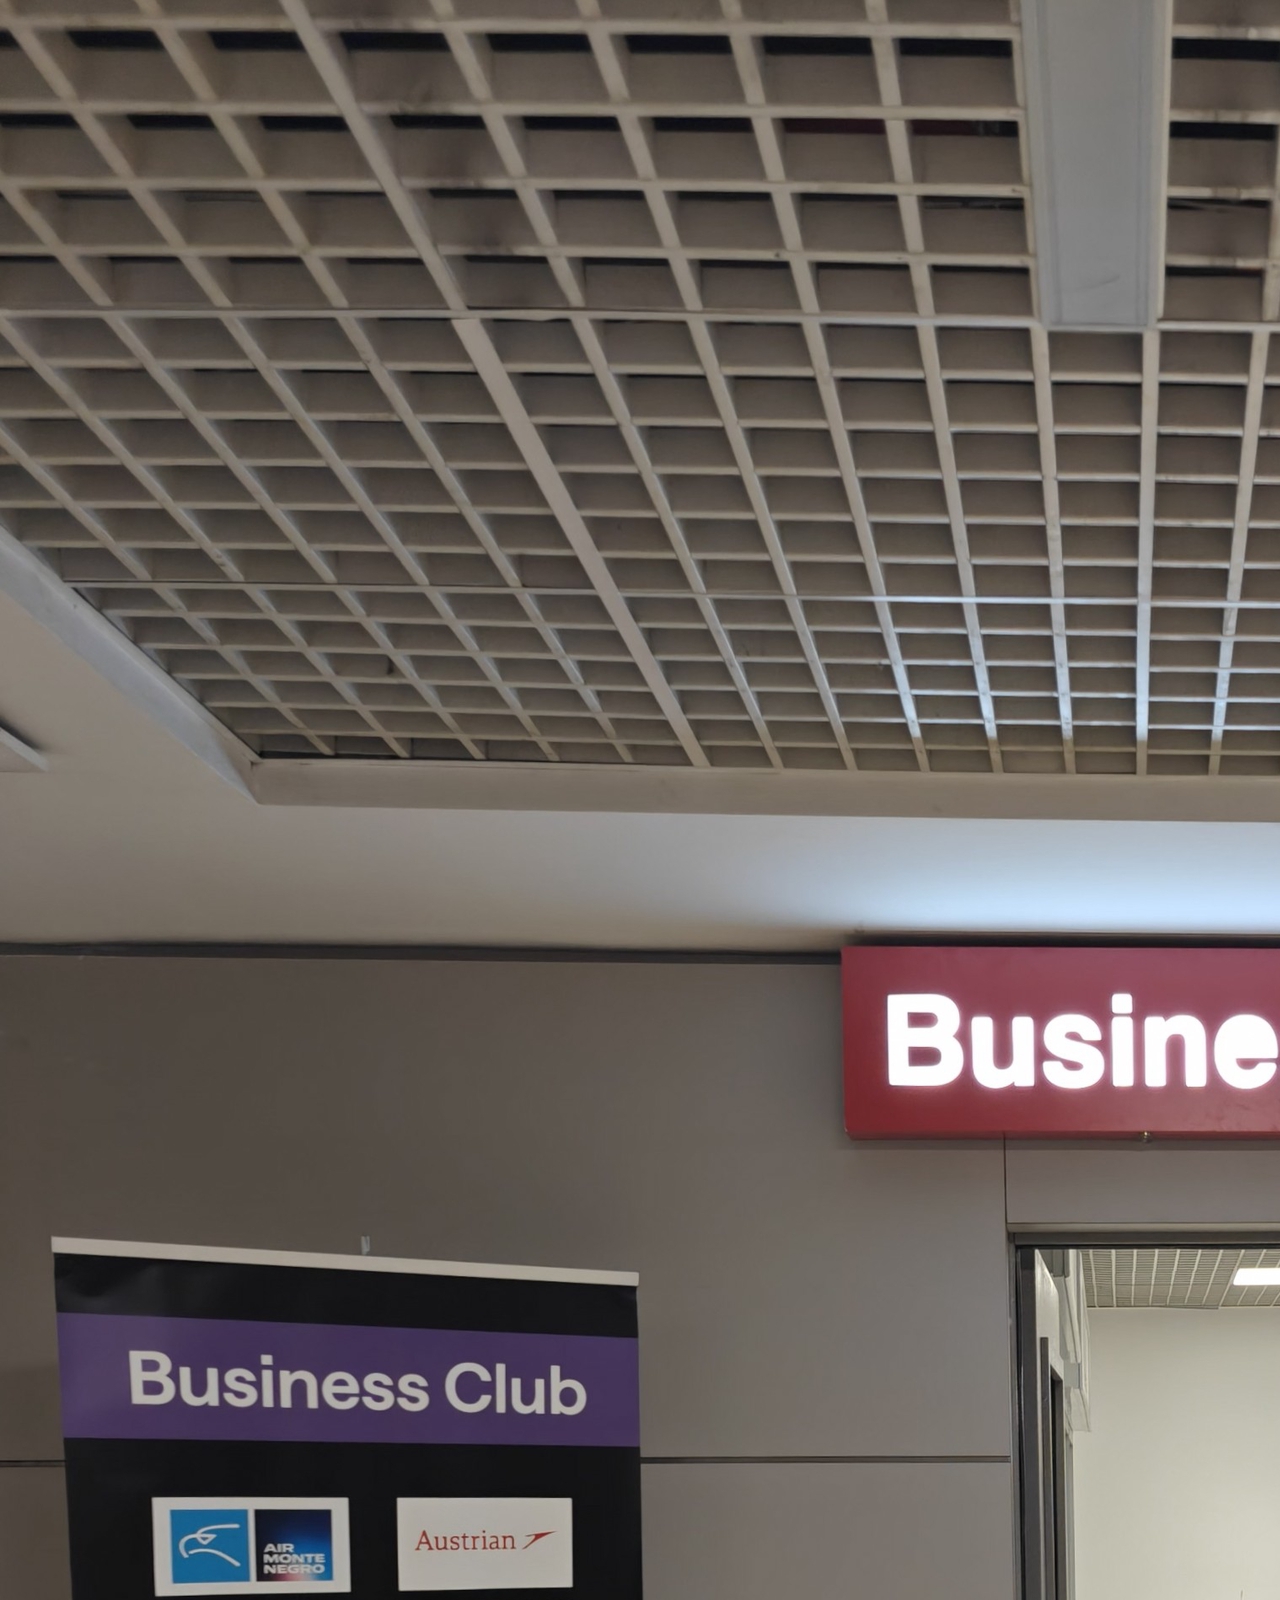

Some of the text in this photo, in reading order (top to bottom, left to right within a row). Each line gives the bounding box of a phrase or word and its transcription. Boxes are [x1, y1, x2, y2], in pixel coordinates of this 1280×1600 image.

[128, 1349, 587, 1416] Business Club
[415, 1530, 517, 1552] Austrian
[263, 1543, 295, 1553] AIR
[263, 1553, 326, 1563] MONTE
[263, 1564, 326, 1574] NEGRO
